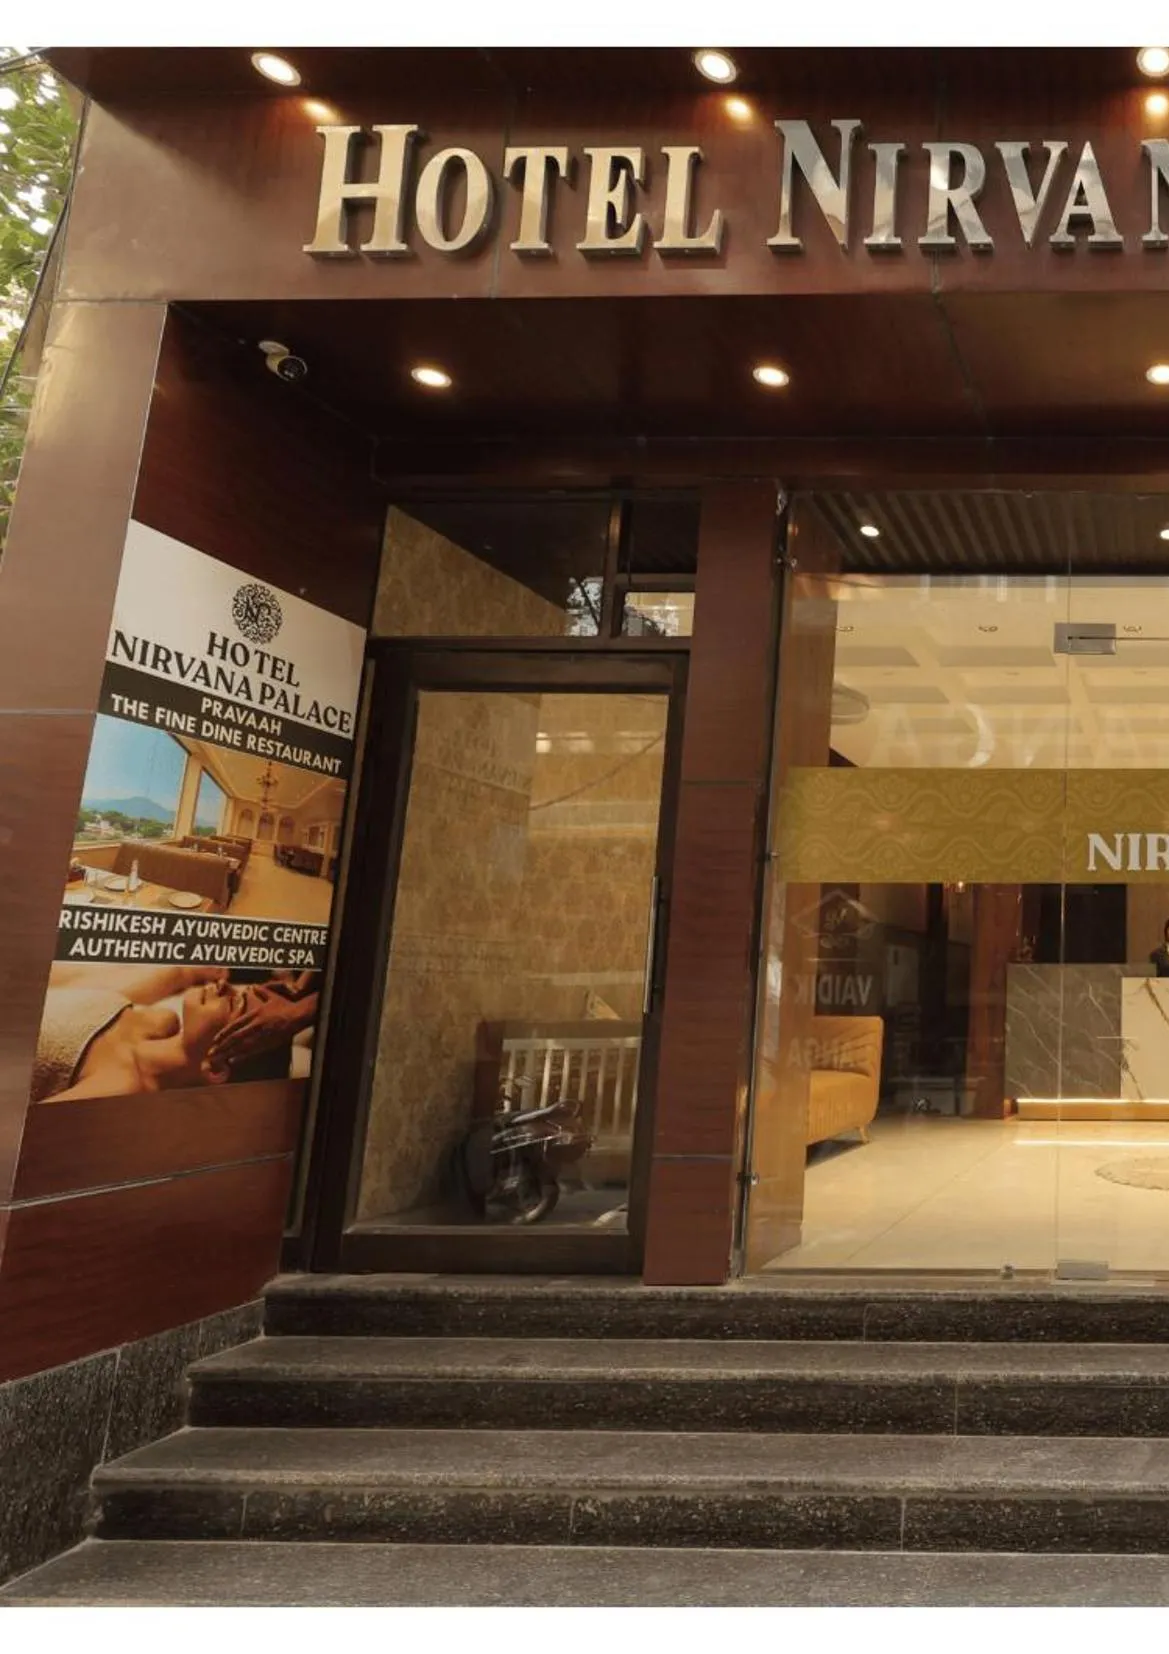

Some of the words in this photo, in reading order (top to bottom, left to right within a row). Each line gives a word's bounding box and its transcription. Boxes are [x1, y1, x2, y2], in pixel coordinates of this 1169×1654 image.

[302, 123, 725, 258] HOTEL
[111, 629, 253, 702] NIRVANA
[258, 681, 352, 734] PALACE
[206, 631, 300, 688] HOTEL
[111, 693, 150, 720] THE
[155, 706, 198, 734] FINE
[201, 720, 243, 747] DINE
[247, 733, 343, 775] RESTAURANT
[200, 696, 283, 737] PRAVAAH
[58, 909, 167, 935] RISHIKESH
[170, 918, 270, 942] AYURVEDIC
[273, 926, 329, 946] CENTRE
[68, 936, 187, 961] AUTHENTIC
[189, 943, 285, 965] AYURVEDIC
[287, 948, 315, 966] SPA
